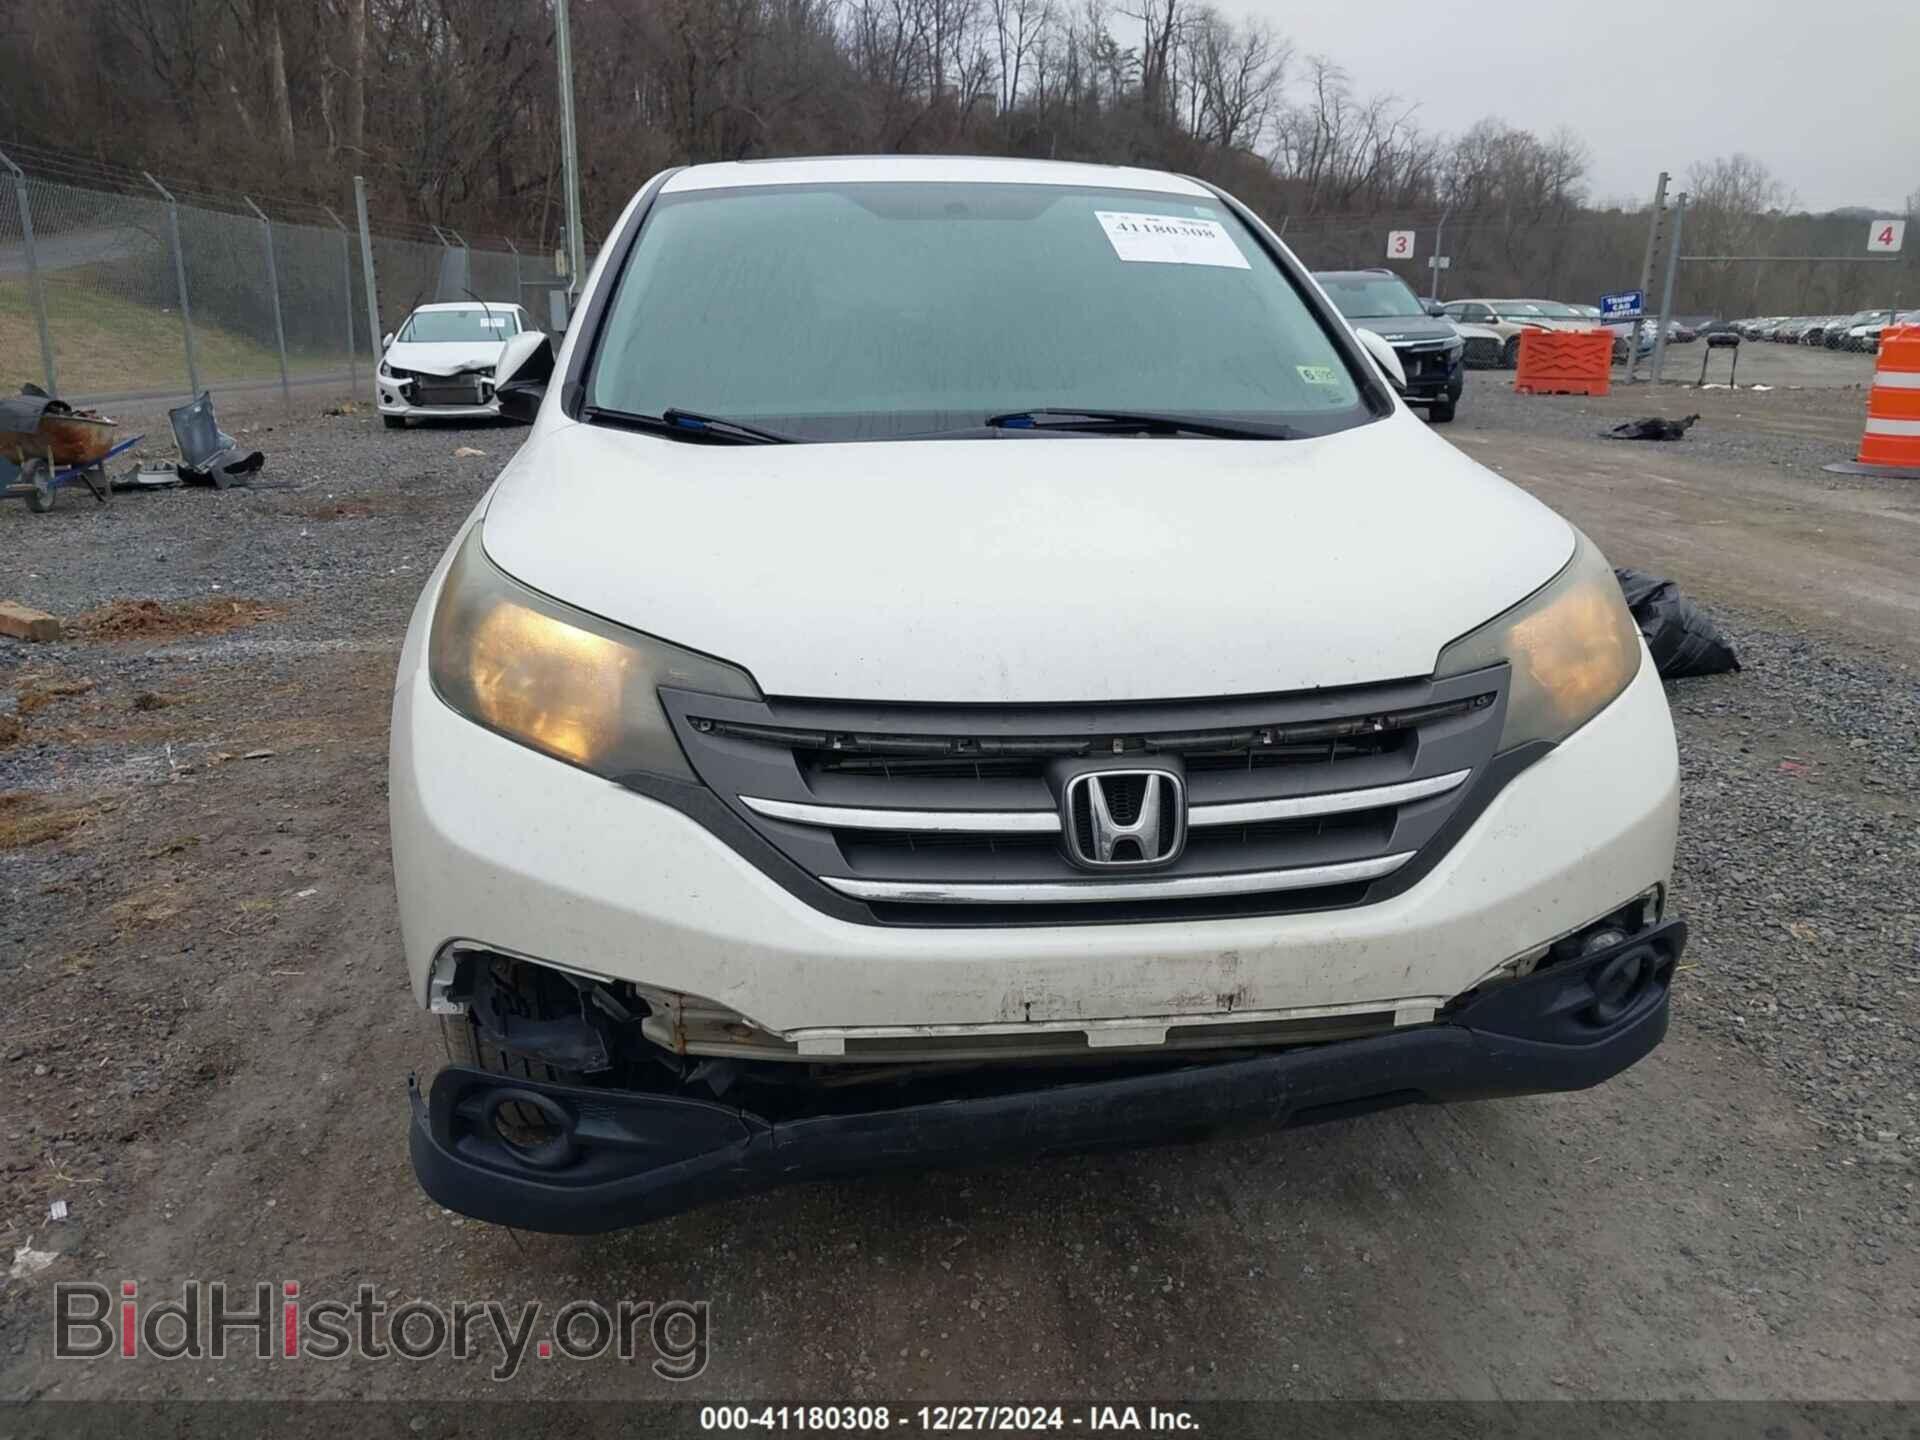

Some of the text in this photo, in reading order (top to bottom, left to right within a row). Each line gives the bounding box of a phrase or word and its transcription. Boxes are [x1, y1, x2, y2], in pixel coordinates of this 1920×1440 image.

[1116, 222, 1216, 239] 41180308
[1878, 226, 1893, 246] 4
[1395, 236, 1407, 253] 3
